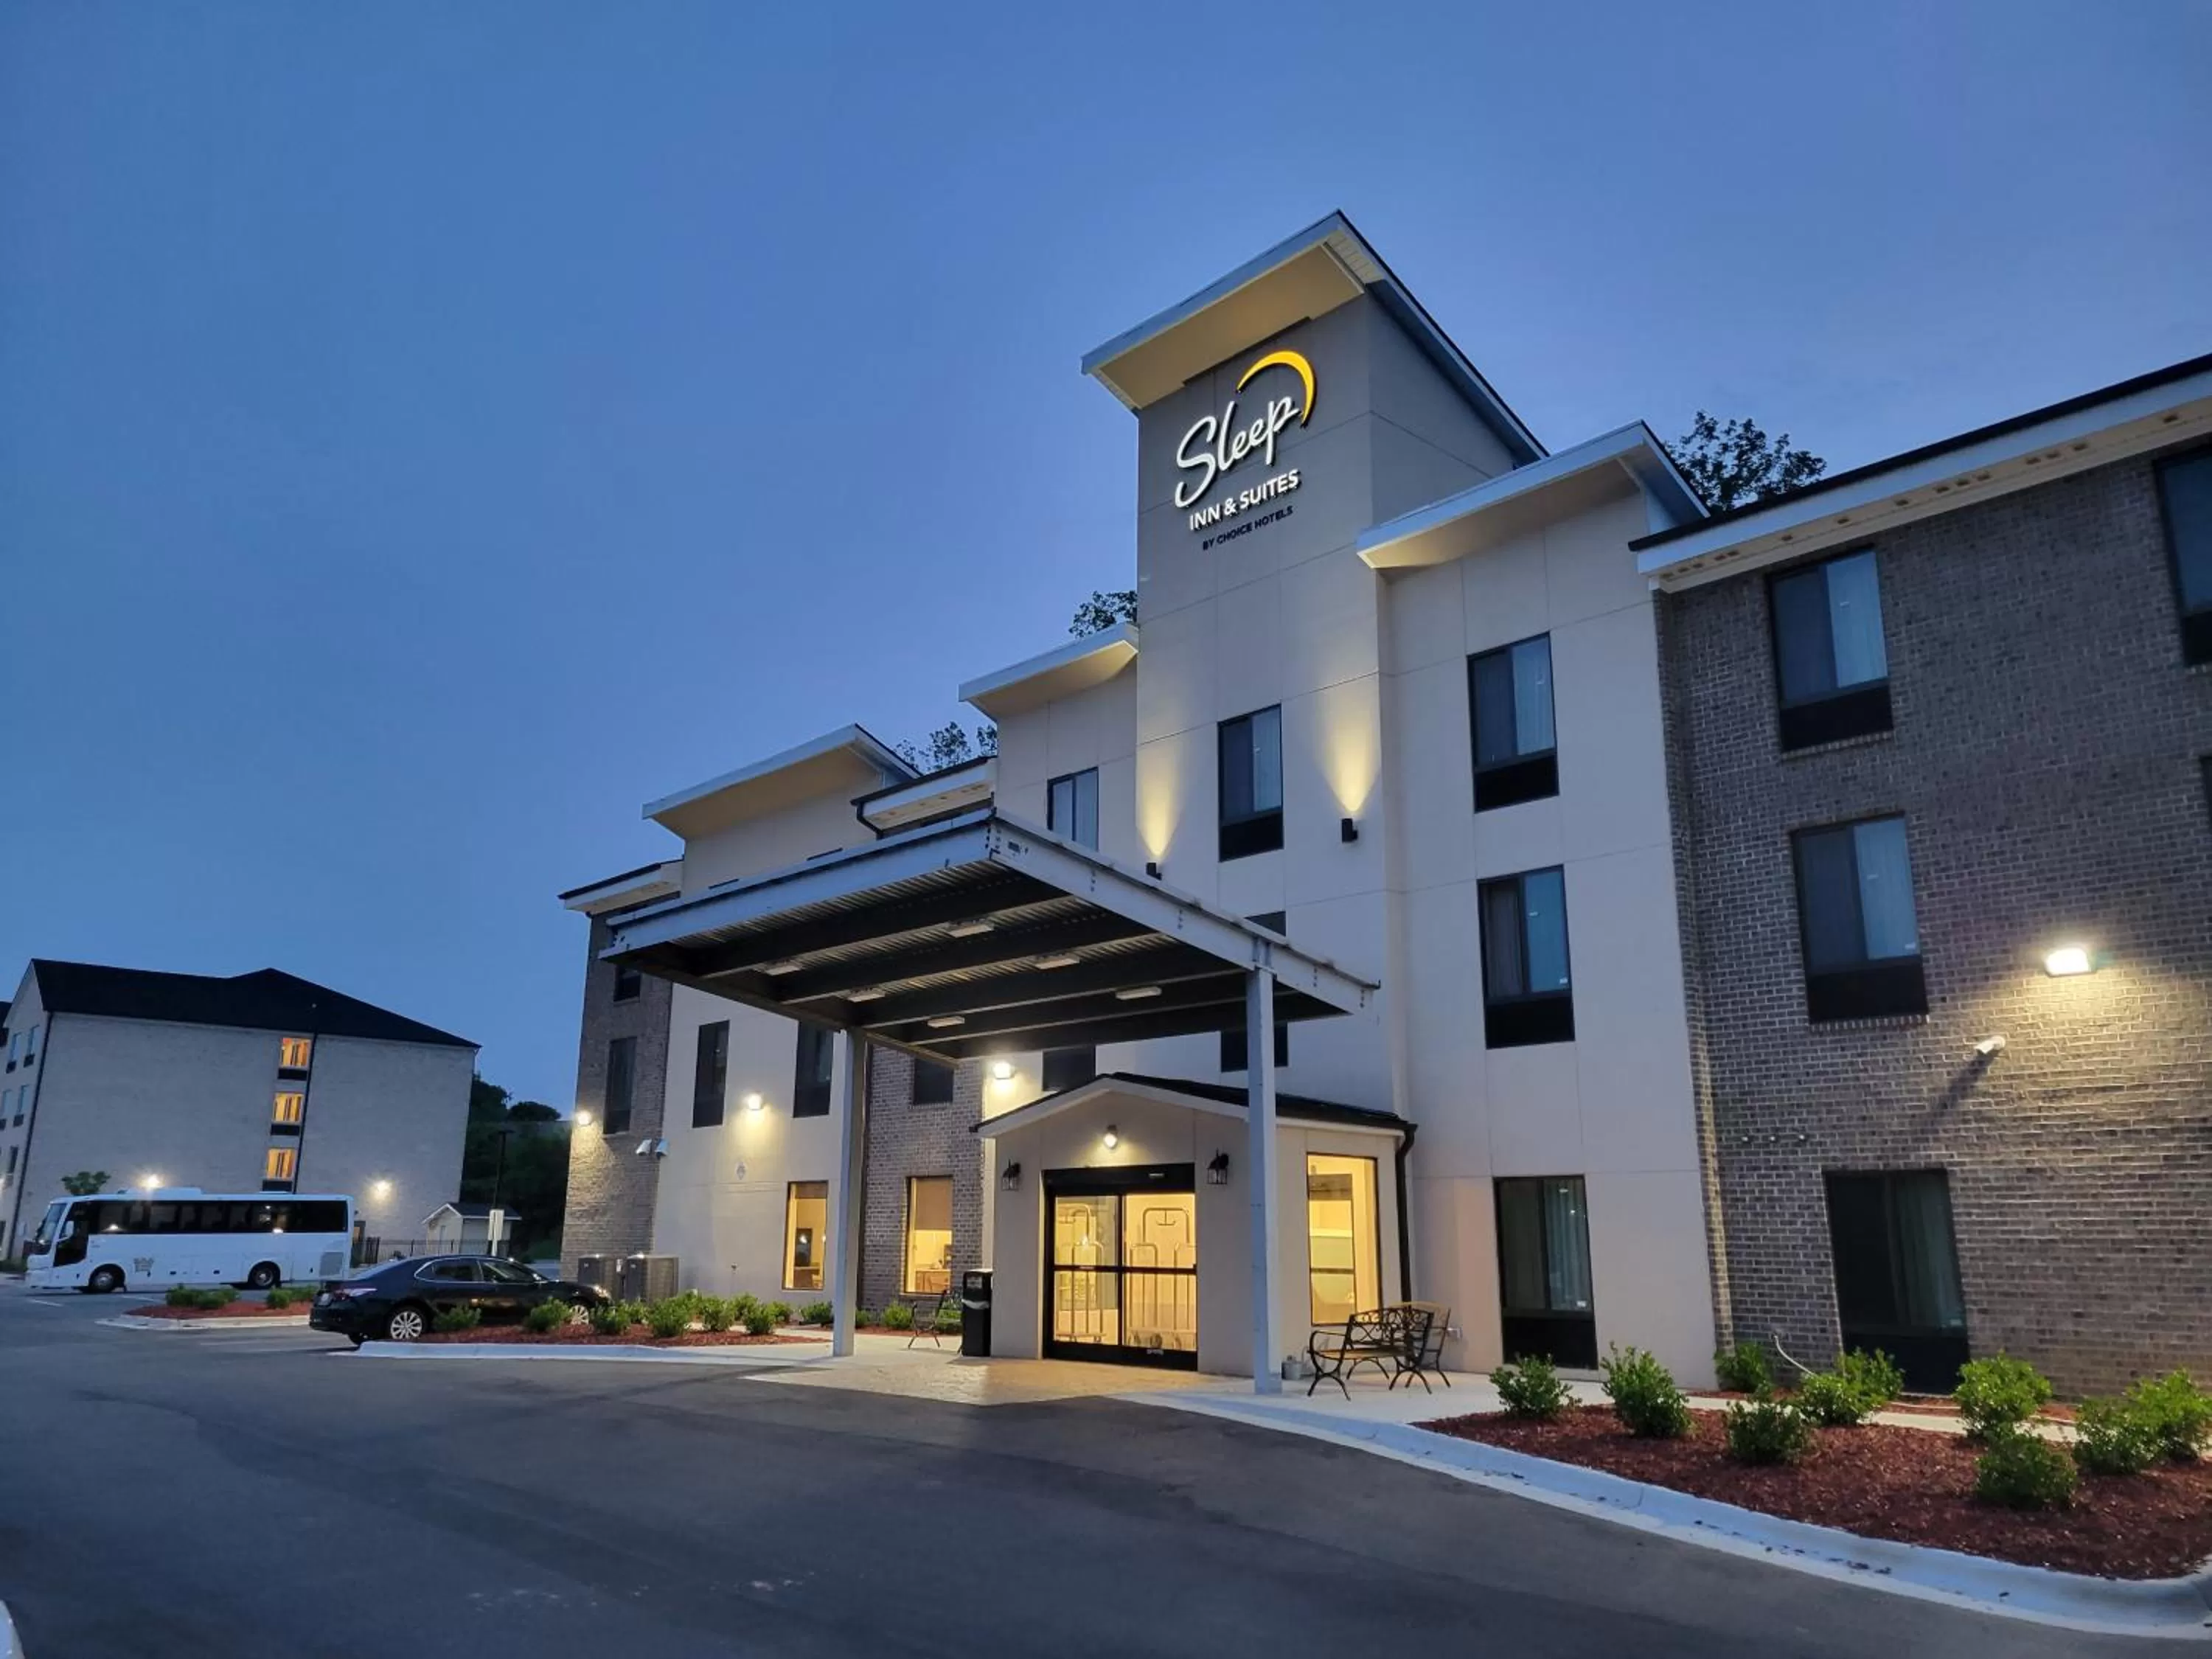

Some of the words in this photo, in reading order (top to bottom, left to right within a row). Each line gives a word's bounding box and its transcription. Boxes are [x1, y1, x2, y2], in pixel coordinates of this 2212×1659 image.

[1175, 397, 1299, 507] Sleep
[1189, 504, 1220, 530] INN
[1224, 498, 1237, 515] &
[1239, 468, 1298, 509] SUITES
[1203, 538, 1215, 551] BY
[1217, 522, 1253, 544] CHOICE
[1254, 506, 1293, 529] HOTELS
